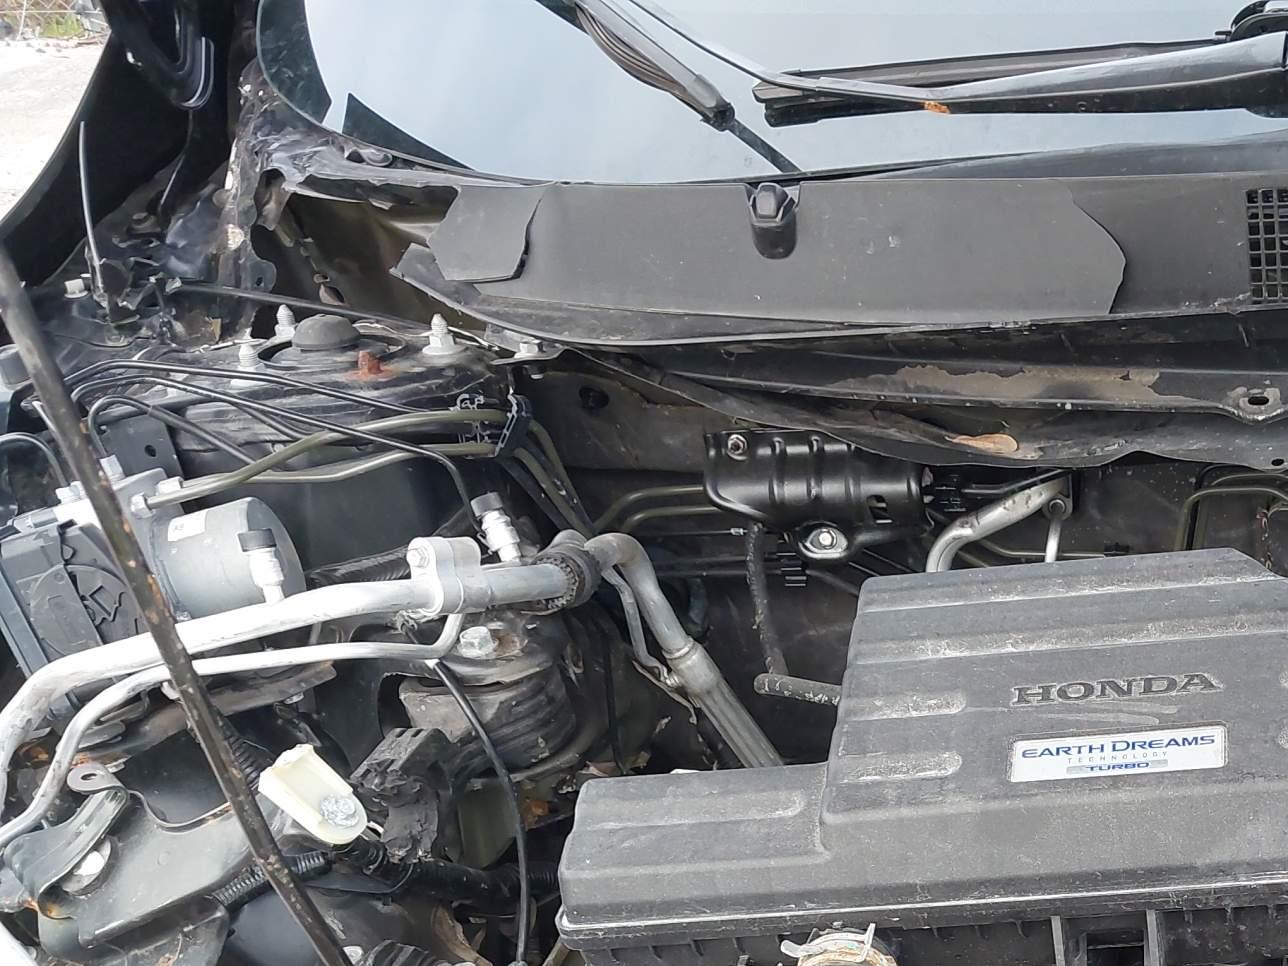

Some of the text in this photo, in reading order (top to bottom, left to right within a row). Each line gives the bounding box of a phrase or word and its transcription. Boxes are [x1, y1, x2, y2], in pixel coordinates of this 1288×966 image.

[1010, 673, 1222, 706] HONDA
[1021, 734, 1216, 759] EARTH DREAMS
[1086, 761, 1150, 773] TURBO
